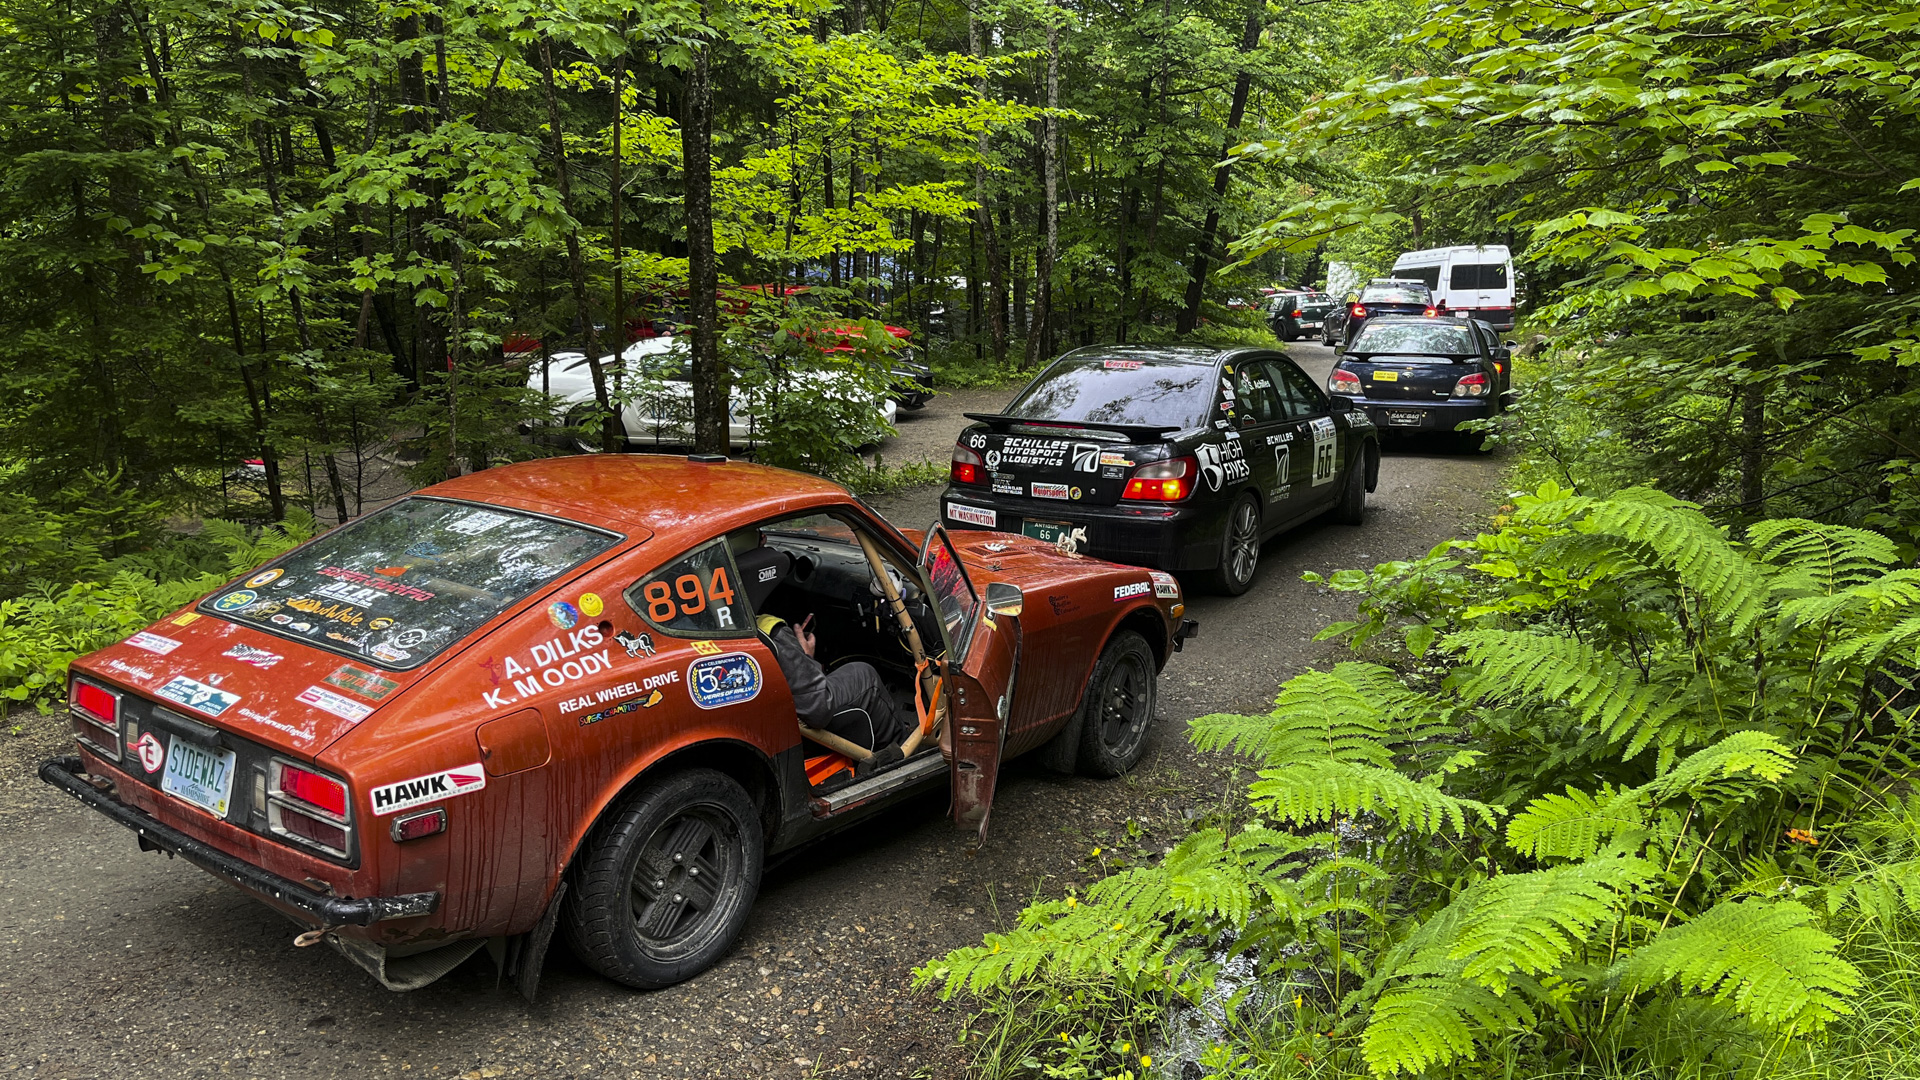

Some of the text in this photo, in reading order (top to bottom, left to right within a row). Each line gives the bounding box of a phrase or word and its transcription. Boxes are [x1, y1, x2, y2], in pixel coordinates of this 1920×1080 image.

[1254, 379, 1270, 389] Achilles
[970, 434, 987, 448] 66
[1216, 440, 1244, 462] HIGH
[1008, 456, 1064, 466] LOGISTICS
[1222, 459, 1250, 481] FIVES
[1317, 444, 1332, 480] 66
[1032, 487, 1067, 498] Motorsports
[950, 508, 994, 526] MT WASHINGTON
[1039, 530, 1051, 540] 66
[316, 566, 371, 584] SUPER
[758, 567, 778, 580] OMP
[643, 566, 735, 623] 894
[1114, 581, 1151, 599] FEDERAL
[1154, 584, 1172, 594] HAWK
[716, 606, 734, 628] R
[504, 624, 604, 680] A. DILKS
[707, 658, 736, 667] CELEBRATING
[482, 688, 517, 710] K.
[558, 670, 680, 715] REAL WHEEL DRIVE
[703, 686, 753, 701] YEARS OF RALLY
[580, 702, 638, 726] SUPER CHAMPIO
[170, 743, 226, 794] SIDEWAZ
[180, 784, 211, 804] HAMPSHIRE
[374, 774, 449, 808] HAWK
[376, 782, 484, 814] PERFORMANCE BRAKE PADS
